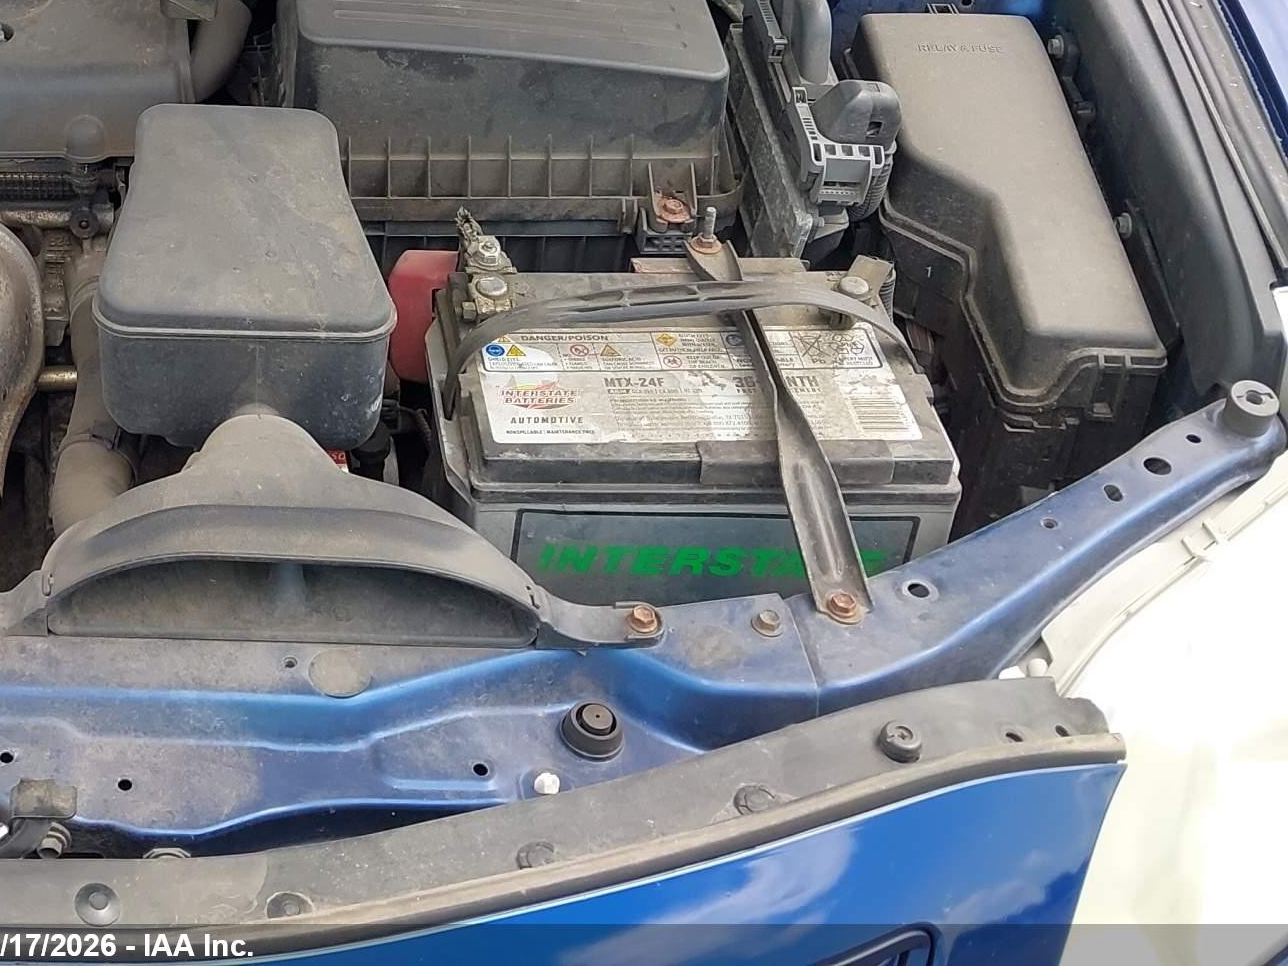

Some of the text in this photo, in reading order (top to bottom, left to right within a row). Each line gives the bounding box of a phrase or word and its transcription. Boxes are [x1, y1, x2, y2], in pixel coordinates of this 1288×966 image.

[917, 42, 957, 52] RELAY
[971, 43, 1002, 53] FUSE
[604, 377, 664, 387] MTX-24F
[539, 541, 888, 578] INTERSTAE
